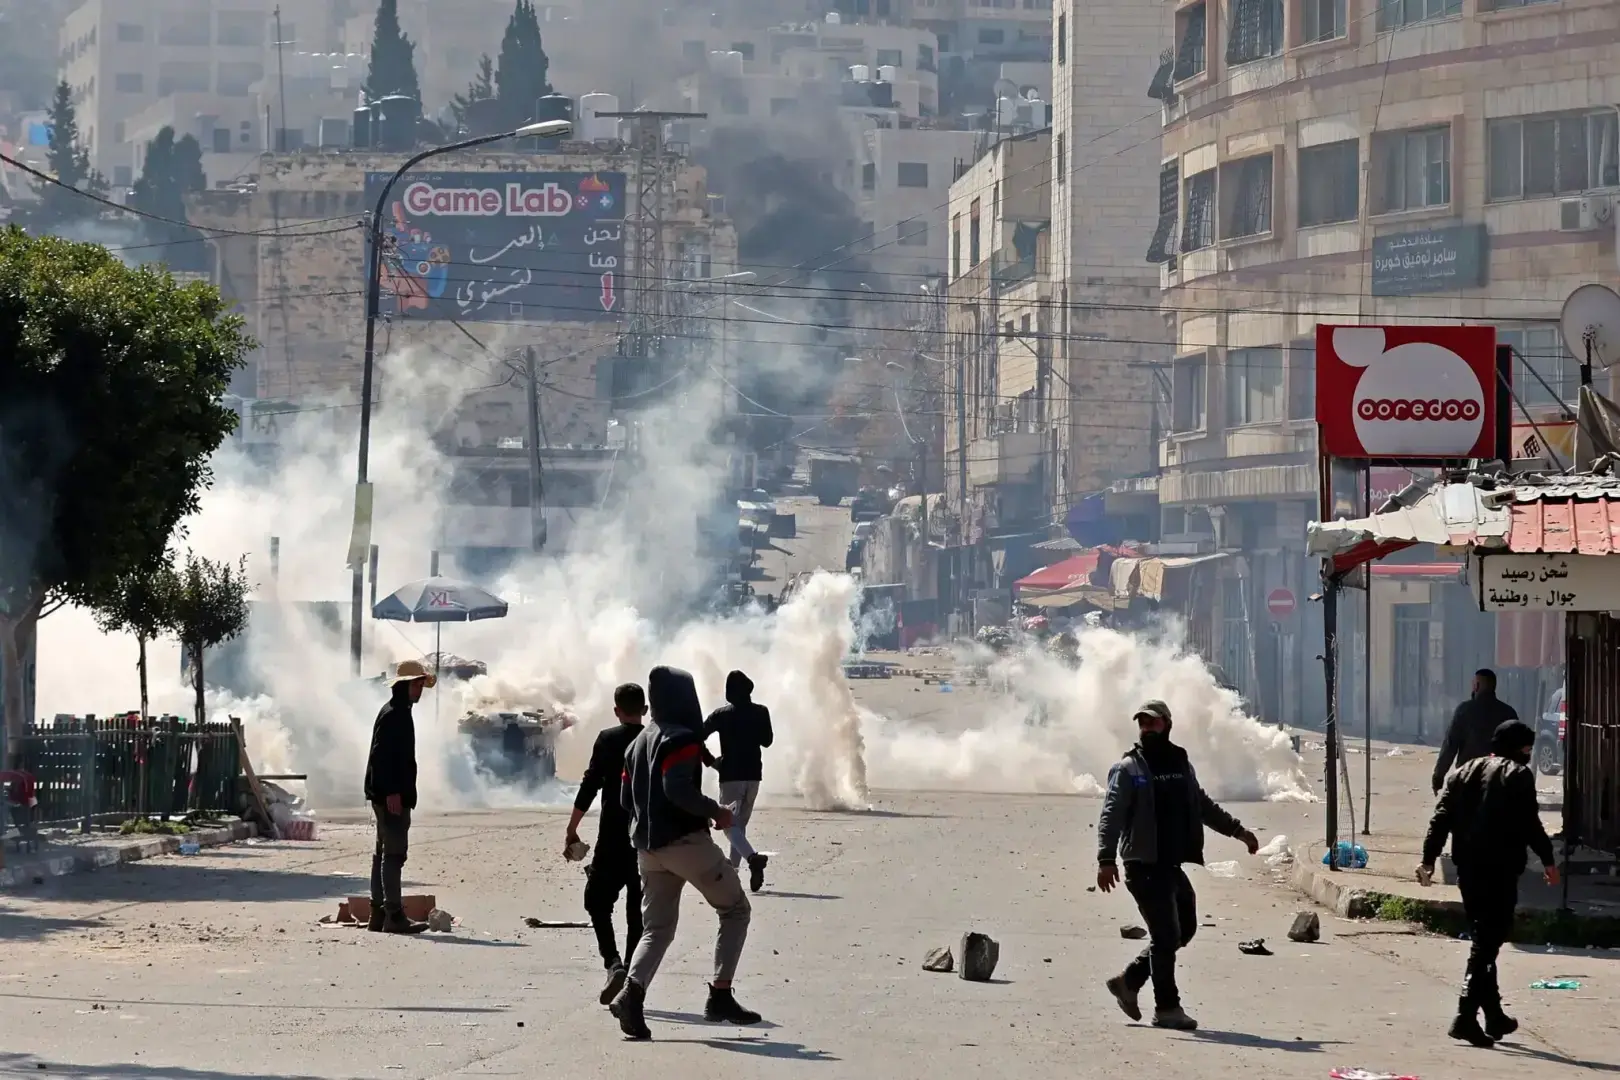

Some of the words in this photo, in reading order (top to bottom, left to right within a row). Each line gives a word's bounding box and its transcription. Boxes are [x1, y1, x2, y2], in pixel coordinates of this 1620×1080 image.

[405, 183, 501, 215] Game
[507, 183, 571, 215] Lab
[583, 224, 621, 245] نحن
[469, 224, 545, 270] إلعب
[588, 252, 617, 268] هنا
[1402, 249, 1431, 269] توفيق
[1432, 247, 1457, 267] سامر
[1359, 400, 1478, 419] ooredoo
[1501, 568, 1535, 582] رصيد
[1539, 561, 1568, 582] شحن
[430, 591, 452, 607] XL
[1489, 588, 1528, 607] وطنية
[1533, 594, 1541, 603] +
[1546, 590, 1577, 606] جوال
